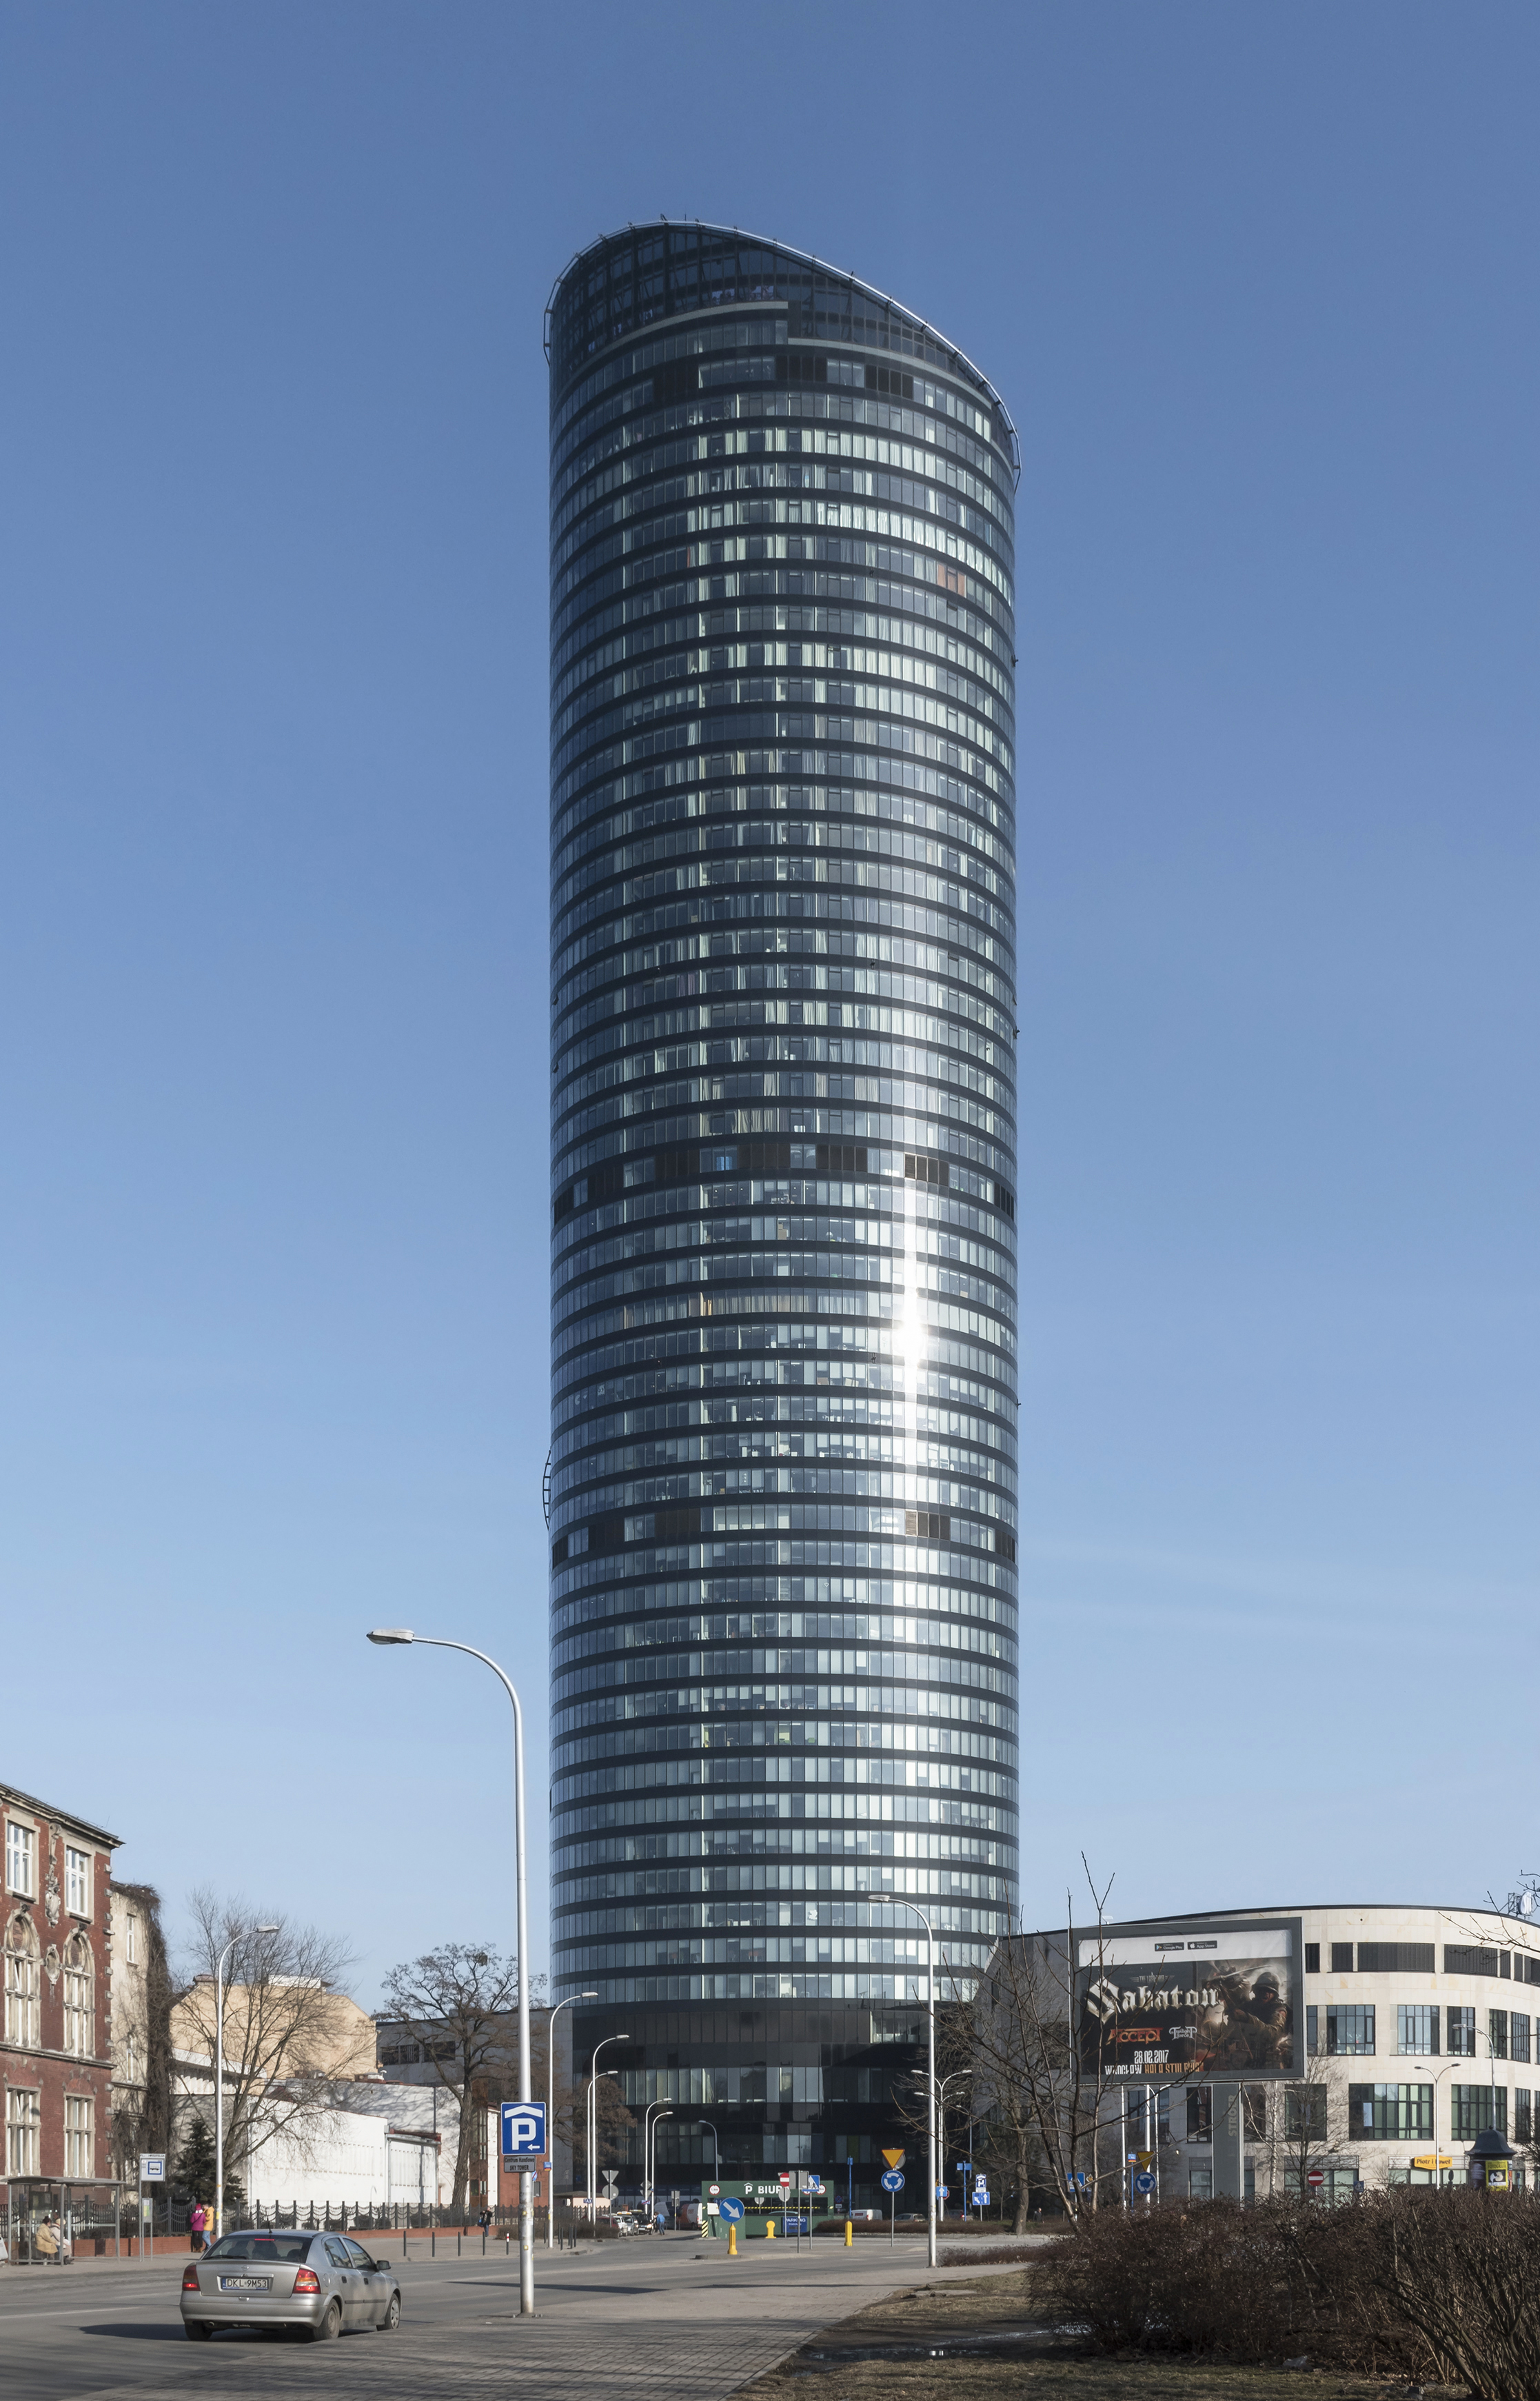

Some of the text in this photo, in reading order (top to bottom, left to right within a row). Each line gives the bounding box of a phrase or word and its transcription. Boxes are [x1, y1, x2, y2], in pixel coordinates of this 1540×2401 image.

[1084, 1976, 1219, 2025] Sabaton
[1134, 2050, 1169, 2064] 28.02.2017
[511, 2118, 536, 2151] P
[758, 2185, 790, 2194] BIUR
